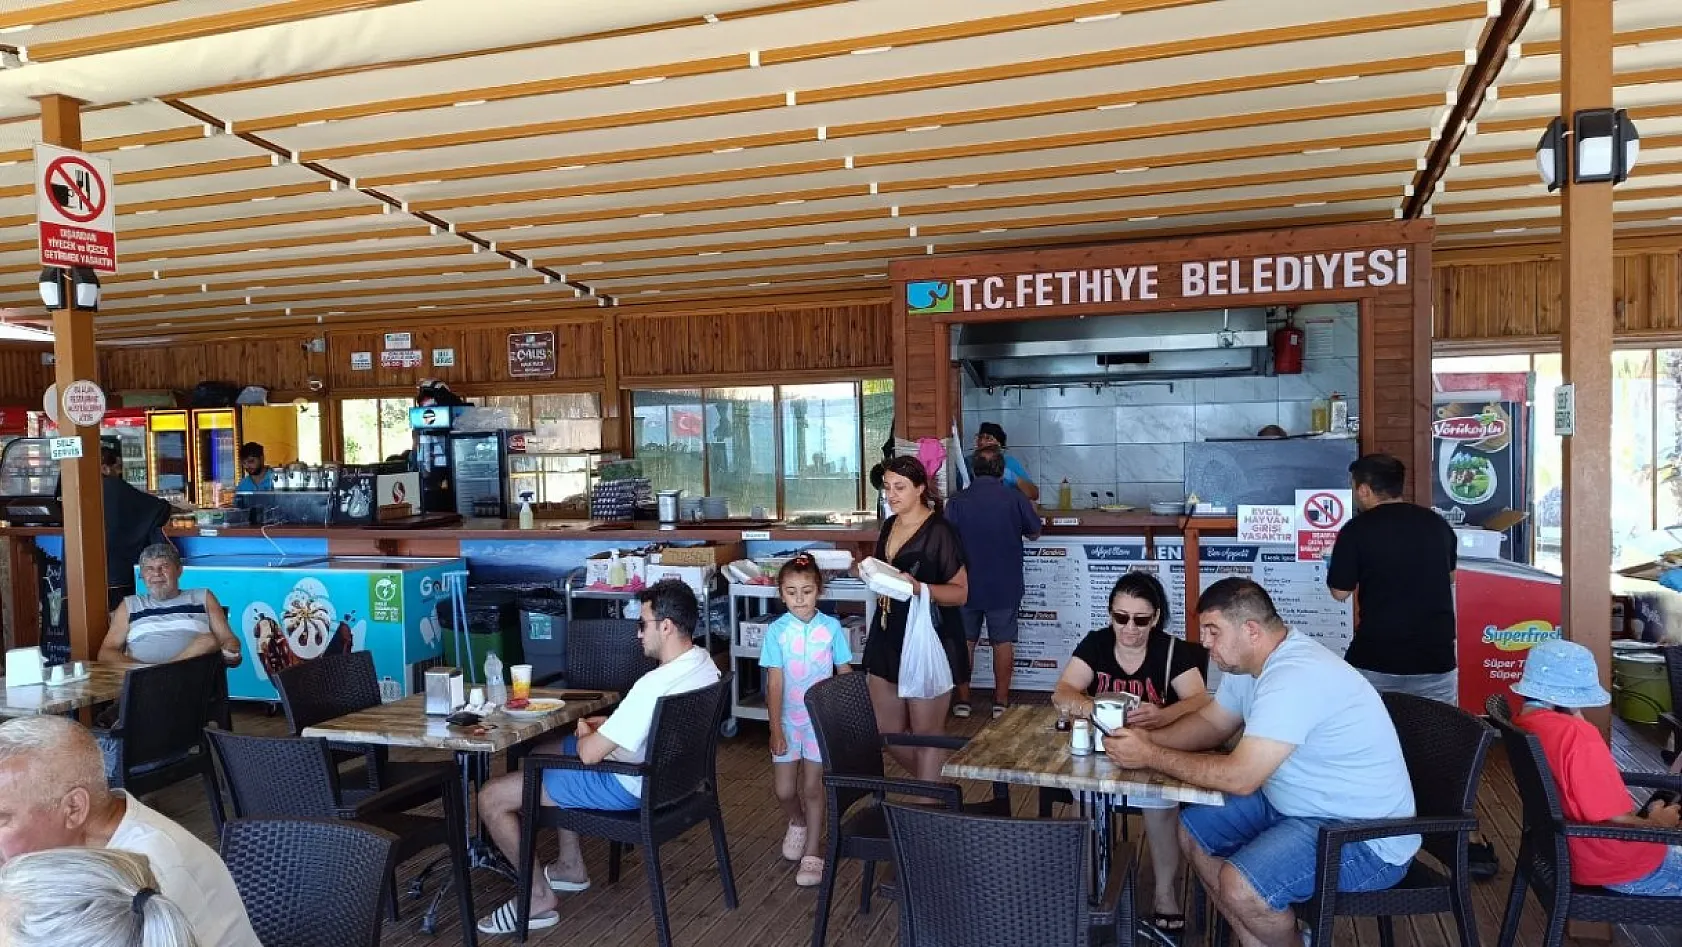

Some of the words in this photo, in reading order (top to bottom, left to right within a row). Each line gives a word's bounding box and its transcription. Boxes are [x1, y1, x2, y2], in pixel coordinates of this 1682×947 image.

[57, 439, 75, 447] SELF
[1244, 516, 1290, 524] HAYVAN
[1241, 532, 1292, 541] YASAKTIR
[1483, 658, 1516, 669] Süper
[1518, 659, 1526, 668] T
[1490, 669, 1523, 679] Süper
